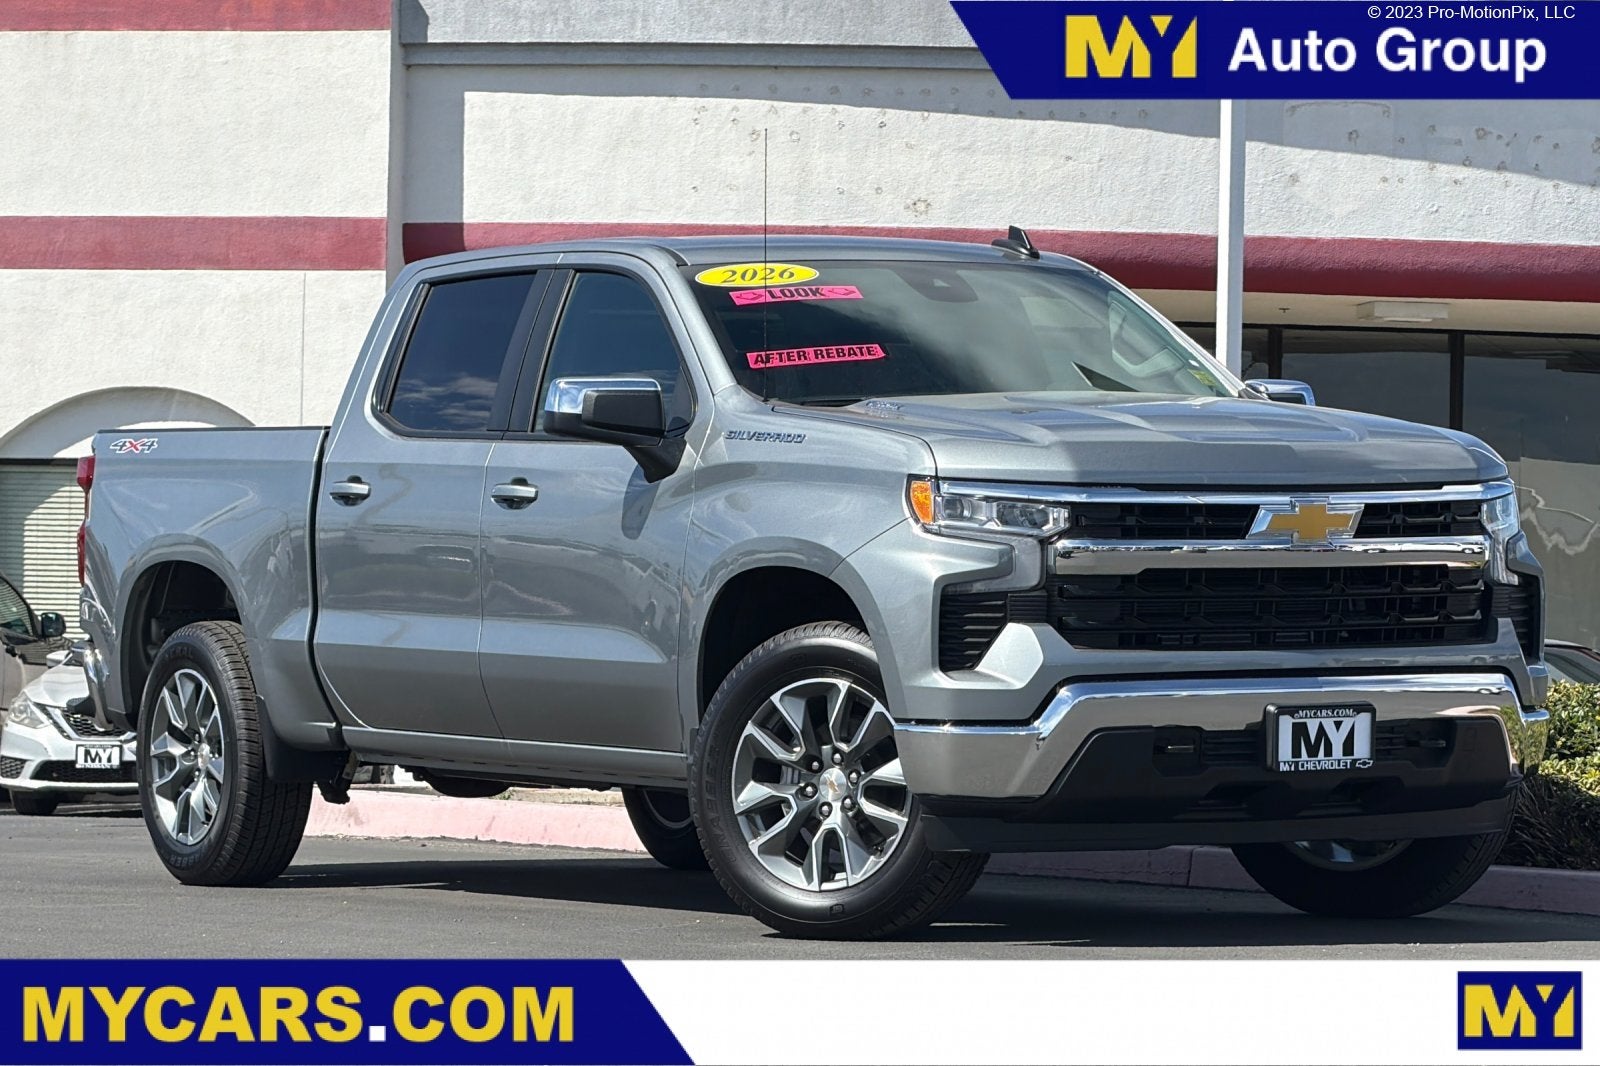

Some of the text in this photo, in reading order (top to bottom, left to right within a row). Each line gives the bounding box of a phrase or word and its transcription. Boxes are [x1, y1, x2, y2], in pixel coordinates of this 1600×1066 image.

[721, 267, 795, 284] 2026
[767, 286, 827, 299] LOOK
[753, 345, 878, 365] AFTER REBATE
[724, 429, 807, 445] SILVERADO
[1298, 708, 1354, 718] MYCARS.COM
[1291, 719, 1355, 760] MY
[83, 748, 113, 764] MY
[1279, 760, 1352, 772] MY CHEVROLET
